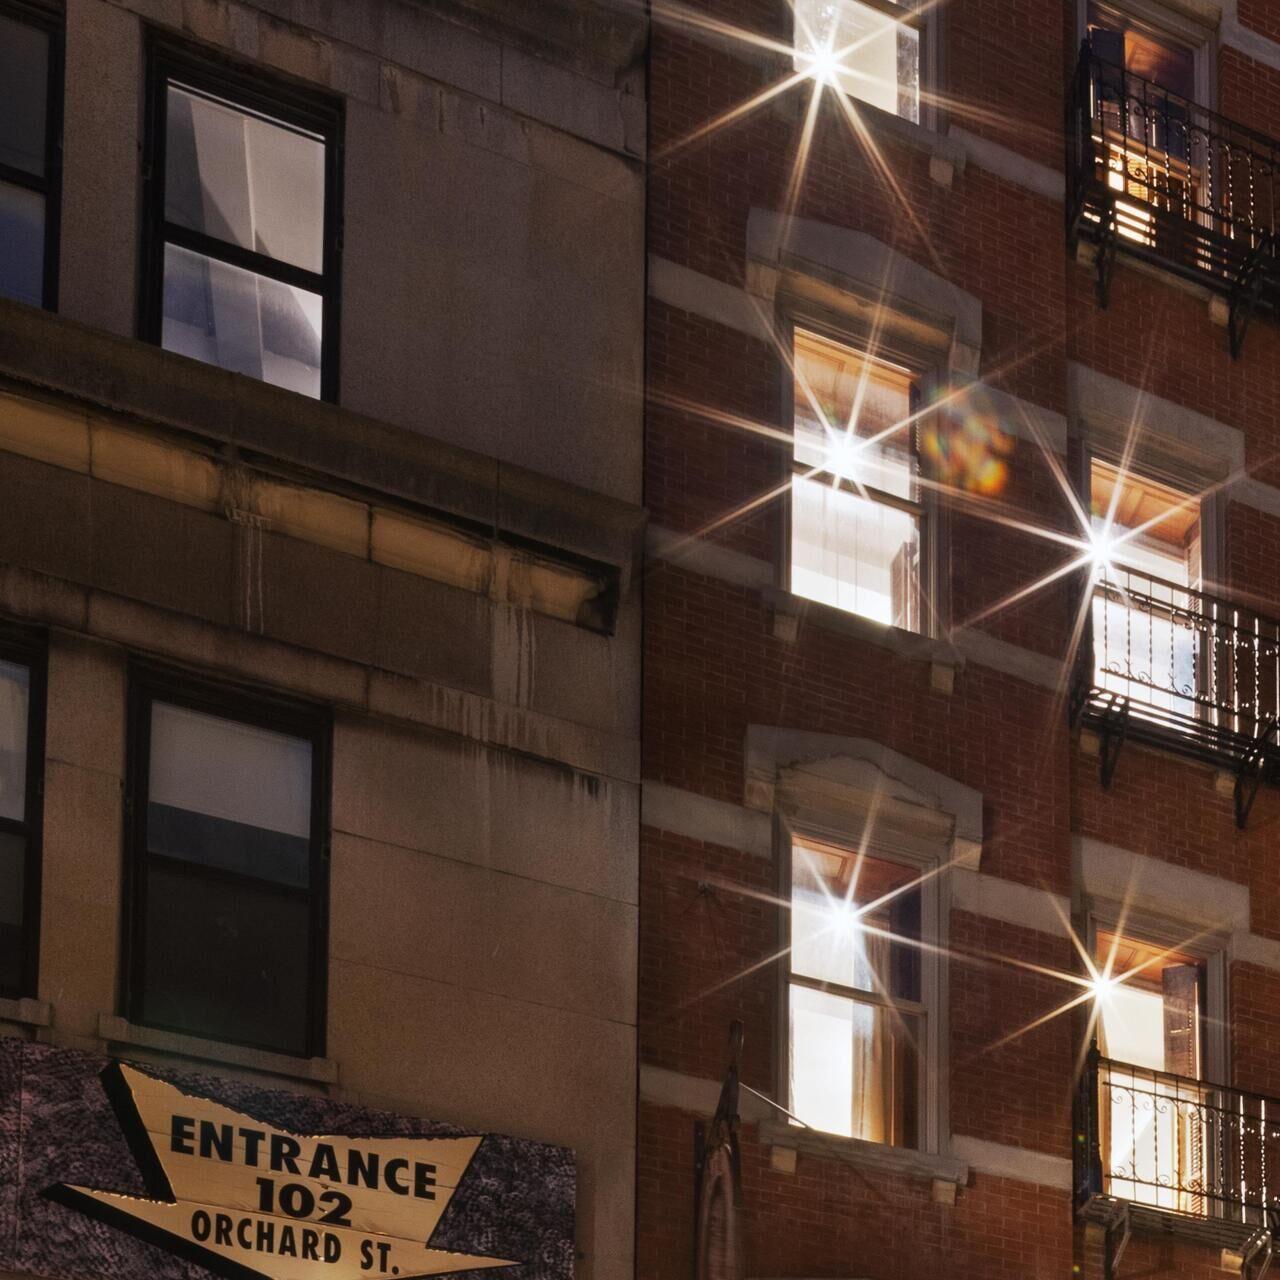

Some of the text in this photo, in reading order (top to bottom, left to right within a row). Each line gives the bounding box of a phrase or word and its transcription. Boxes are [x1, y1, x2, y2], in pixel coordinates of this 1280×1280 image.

[170, 1114, 438, 1201] ENTRANCE
[255, 1176, 353, 1227] 102
[190, 1209, 400, 1276] ORCHARD ST.
